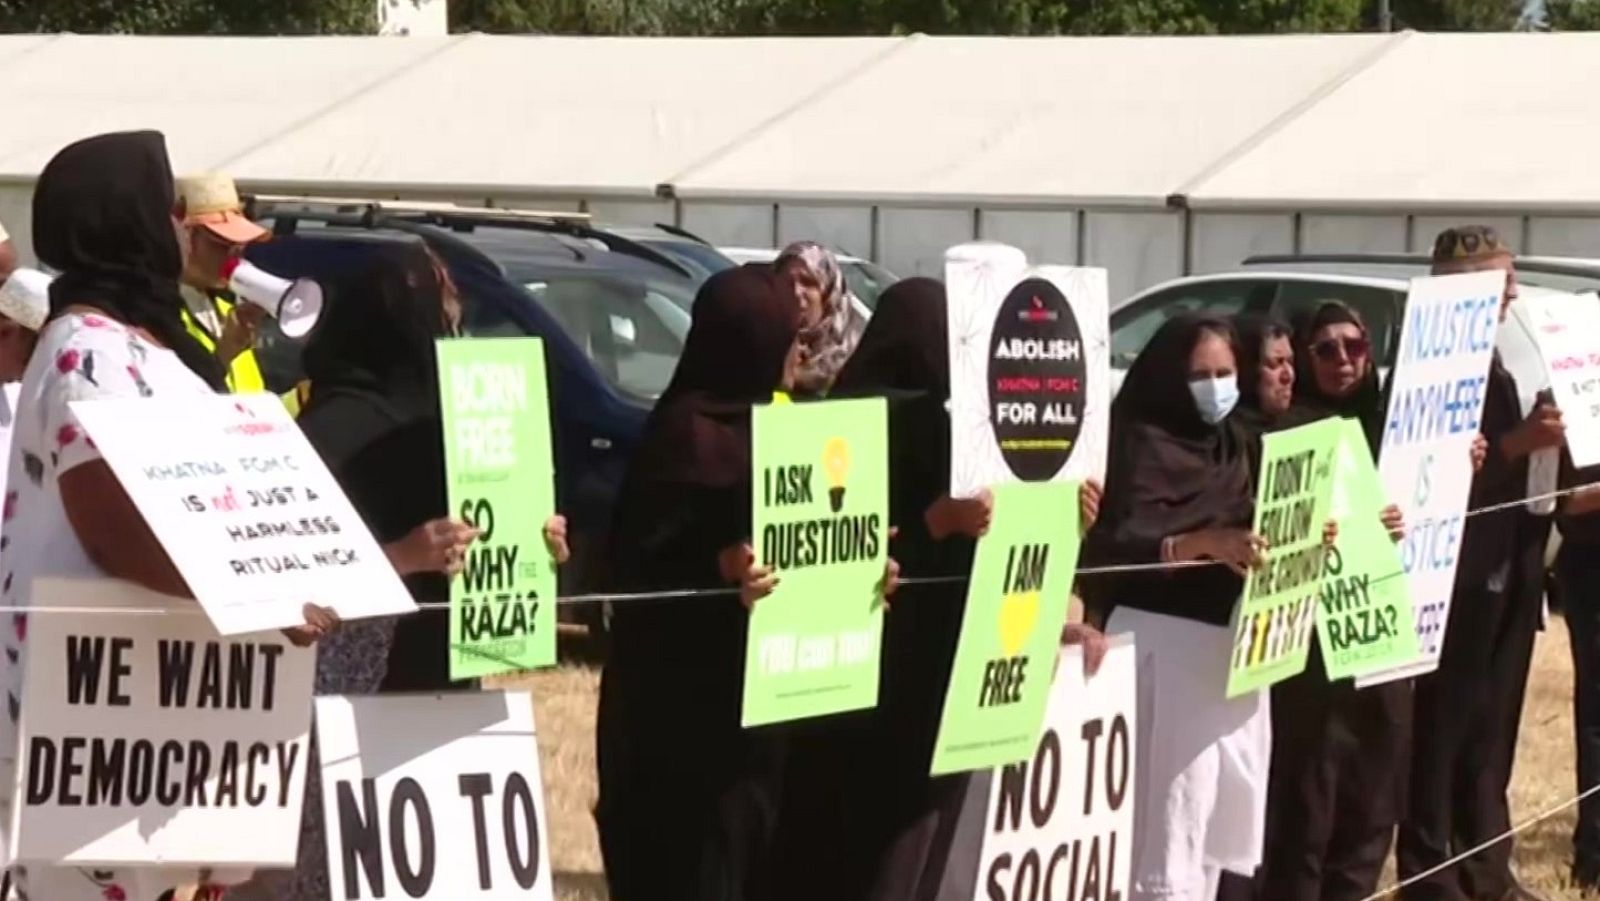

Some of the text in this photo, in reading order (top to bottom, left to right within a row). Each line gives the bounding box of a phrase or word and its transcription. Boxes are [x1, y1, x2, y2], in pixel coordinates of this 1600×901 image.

[995, 338, 1080, 360] ABOLISH
[1403, 295, 1498, 366] INJUSTICE
[450, 361, 528, 413] BORN
[997, 402, 1077, 425] FOR ALL
[455, 416, 518, 469] FREE
[181, 494, 206, 512] IS
[247, 487, 296, 507] JUST
[304, 488, 319, 502] A
[765, 464, 813, 507] I ASK
[1263, 461, 1273, 503] I
[226, 515, 341, 542] HARMLESS
[460, 498, 494, 543] SO
[763, 513, 880, 571] QUESTIONS
[229, 548, 360, 577] RITUAL NICK
[462, 545, 518, 594] WHY
[1003, 543, 1050, 595] I AM
[460, 590, 539, 643] RAZA?
[1320, 573, 1370, 614] WHY
[1326, 603, 1399, 652] RAZA?
[66, 635, 285, 710] WE WANT
[978, 656, 1029, 708] FREE
[26, 736, 299, 808] DEMOCRACY
[994, 712, 1130, 834] NO TO
[335, 771, 540, 899] NO TO
[986, 831, 1122, 901] SOCIAL
